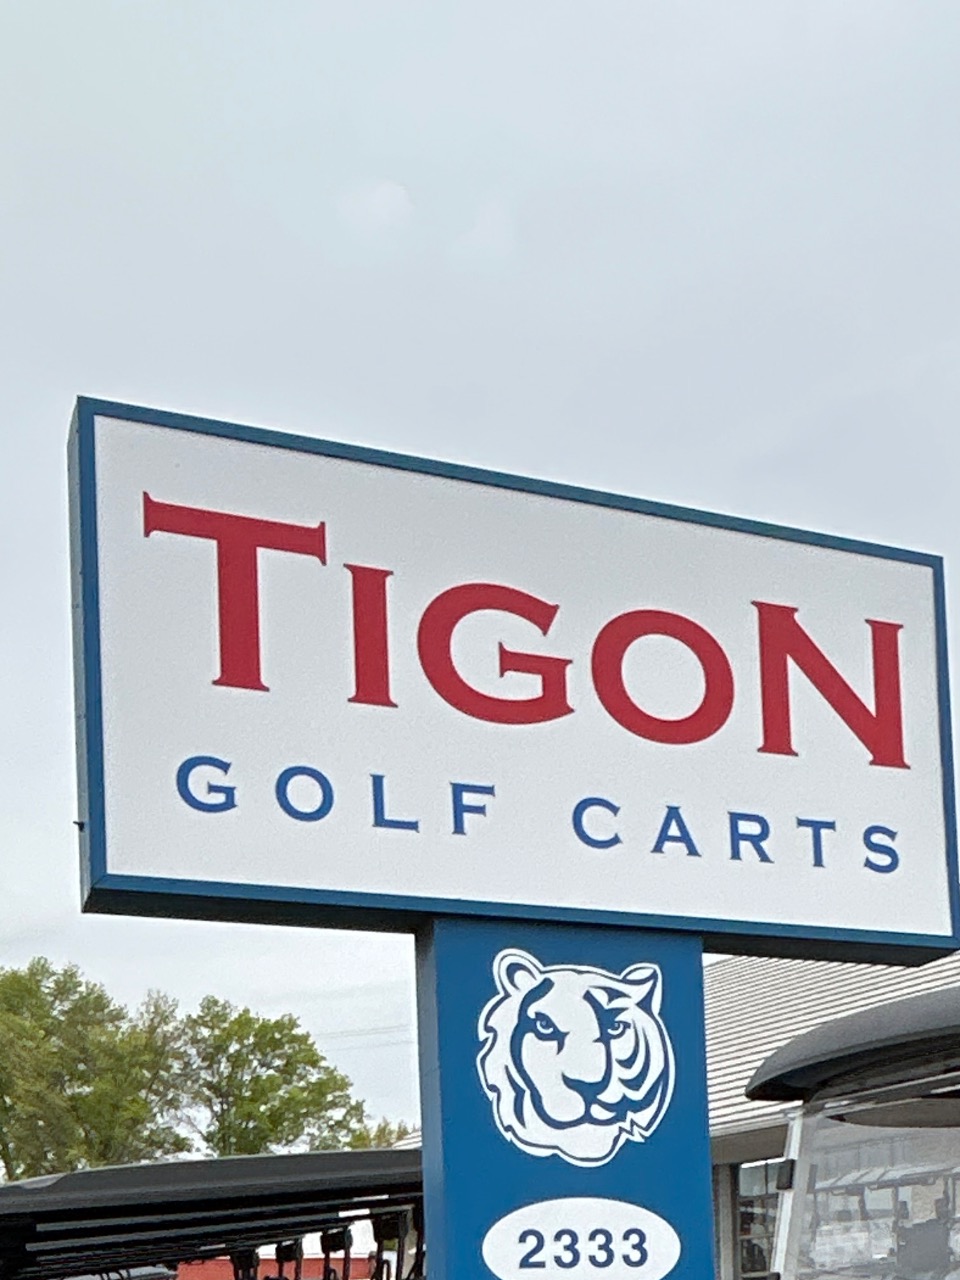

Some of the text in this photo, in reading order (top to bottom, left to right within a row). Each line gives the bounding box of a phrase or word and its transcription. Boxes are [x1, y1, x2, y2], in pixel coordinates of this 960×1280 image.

[176, 755, 901, 875] GOLF CARTS
[517, 1227, 649, 1270] 2333
